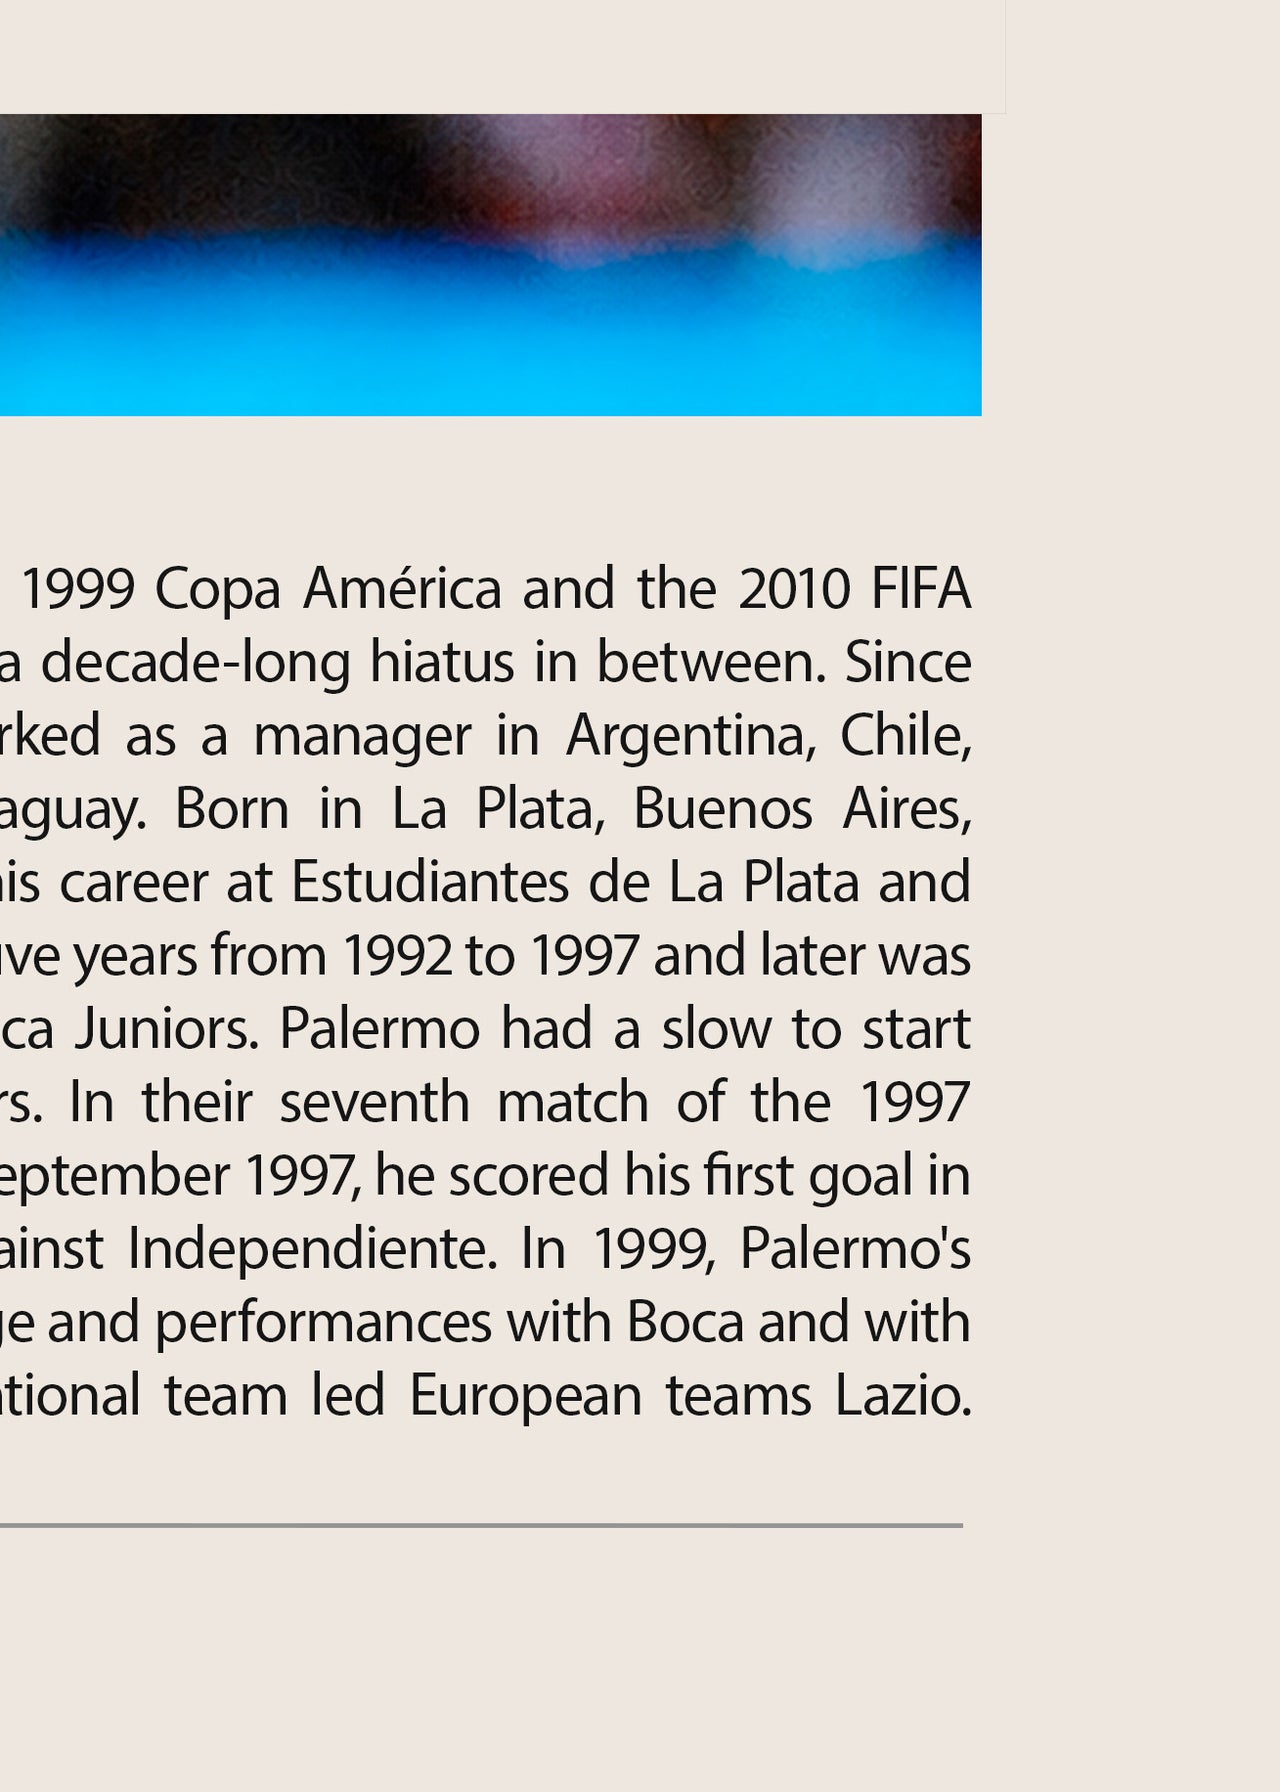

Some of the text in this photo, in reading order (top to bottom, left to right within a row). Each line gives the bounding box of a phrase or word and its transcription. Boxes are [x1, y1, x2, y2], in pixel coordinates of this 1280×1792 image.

[22, 566, 136, 611] 1999
[155, 564, 281, 622] Copa
[301, 564, 502, 611] América
[522, 562, 615, 611] and
[635, 562, 718, 611] the
[738, 566, 852, 611] 2010
[873, 564, 974, 610] FIFA
[125, 722, 177, 758] as
[200, 722, 228, 758] a
[255, 722, 474, 769] manager
[497, 711, 539, 757] in
[564, 710, 817, 769] Argentina,
[840, 709, 973, 764] Chile,
[177, 784, 289, 831] Born
[320, 784, 362, 830] in
[394, 784, 447, 831] La
[478, 782, 606, 837] Plata,
[635, 784, 814, 831] Buenos
[841, 784, 973, 837] Aires,
[71, 942, 199, 989] years
[209, 929, 327, 978] from
[344, 932, 454, 978] 1992
[463, 934, 516, 978] to
[532, 932, 642, 978] 1997
[653, 929, 746, 978] and
[761, 929, 868, 978] later
[876, 942, 972, 978] was
[71, 1077, 114, 1123] In
[140, 1075, 255, 1124] their
[279, 1075, 470, 1124] seventh
[498, 1075, 649, 1124] match
[676, 1075, 730, 1124] of
[749, 1075, 832, 1124] the
[861, 1079, 972, 1124] 1997
[130, 1222, 498, 1282] Independiente.
[523, 1224, 566, 1270] In
[594, 1226, 716, 1277] 1999,
[742, 1222, 972, 1271] Palermo's
[162, 1374, 288, 1418] team
[312, 1369, 385, 1418] led
[411, 1370, 642, 1428] European
[664, 1374, 813, 1418] teams
[837, 1371, 972, 1418] Lazio.
